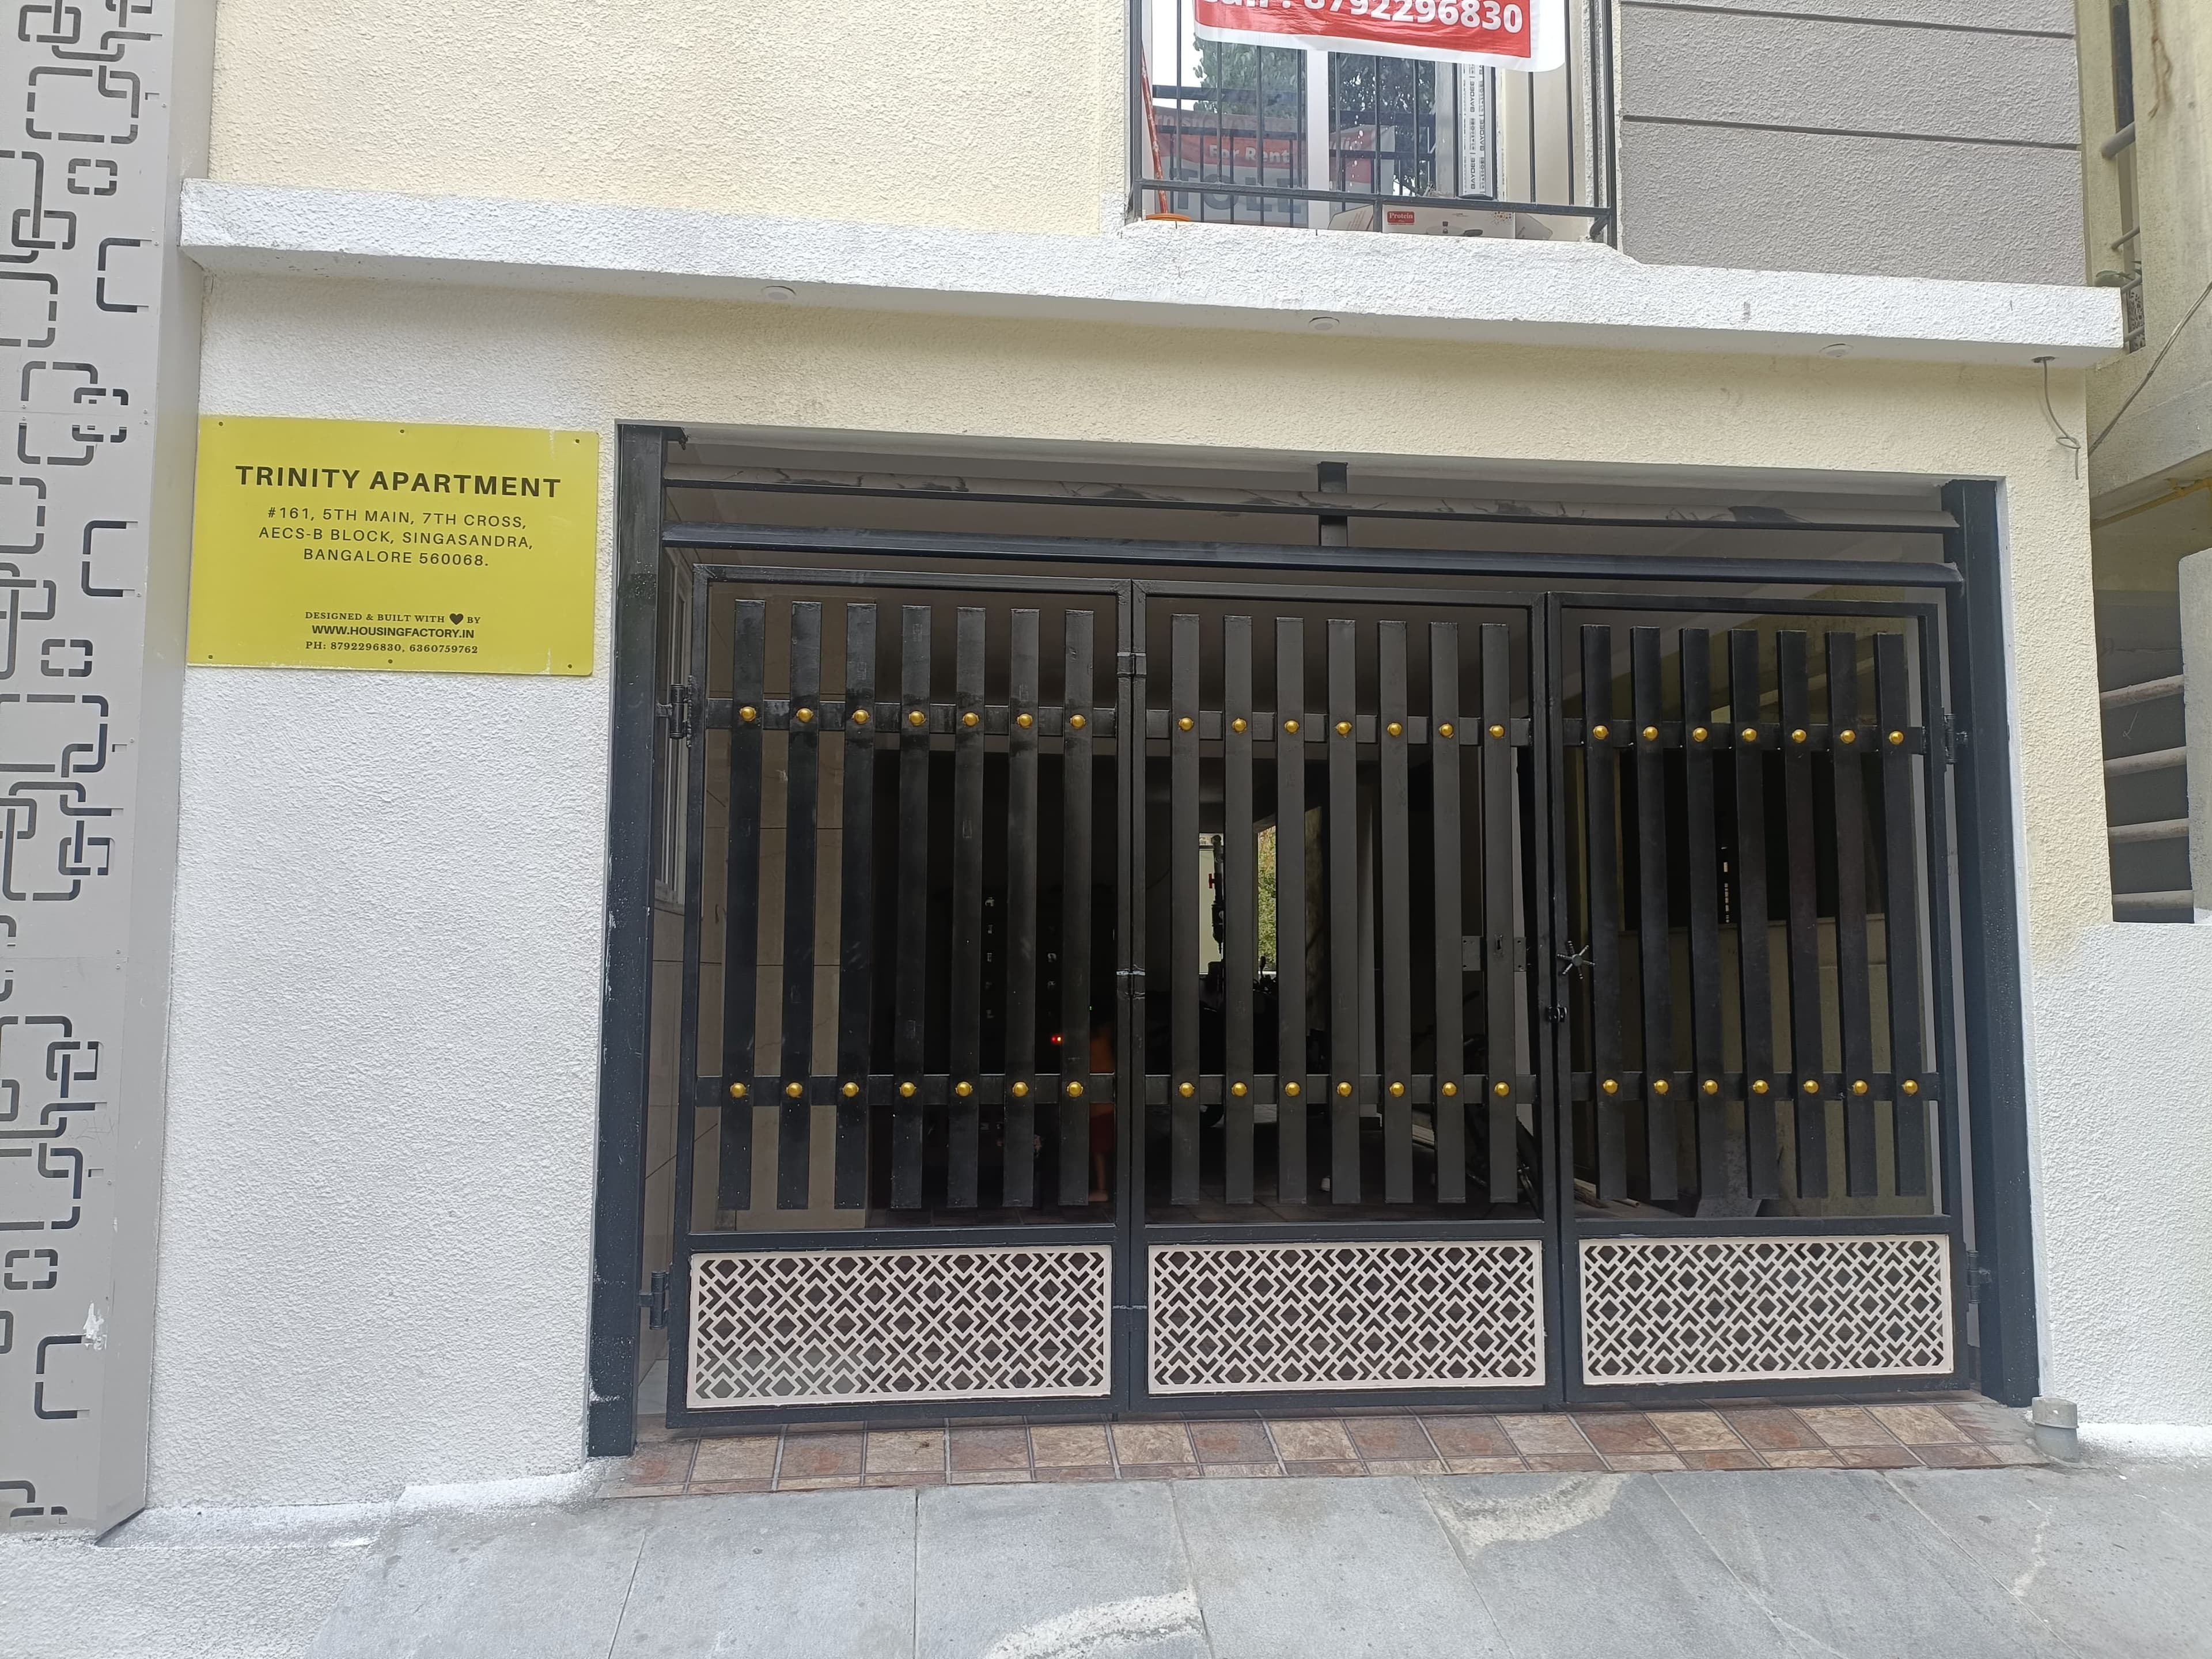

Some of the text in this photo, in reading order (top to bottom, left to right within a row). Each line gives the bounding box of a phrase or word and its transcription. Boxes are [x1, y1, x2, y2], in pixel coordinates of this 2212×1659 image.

[234, 465, 562, 498] TRINITY APARTMENT
[267, 505, 527, 530] #161, 5TH MAIN, 7TH CROSS,
[258, 526, 533, 550] AECS-B BLOCK, SINGASANDRA,
[303, 547, 489, 567] BANGALORE 560068.
[304, 611, 482, 624] DESIGNED & BUILT WITH BY
[311, 624, 475, 639] WWW.HOUSINGFACTORY.IN
[305, 641, 478, 654] PH: 8792296830, 6360759762
